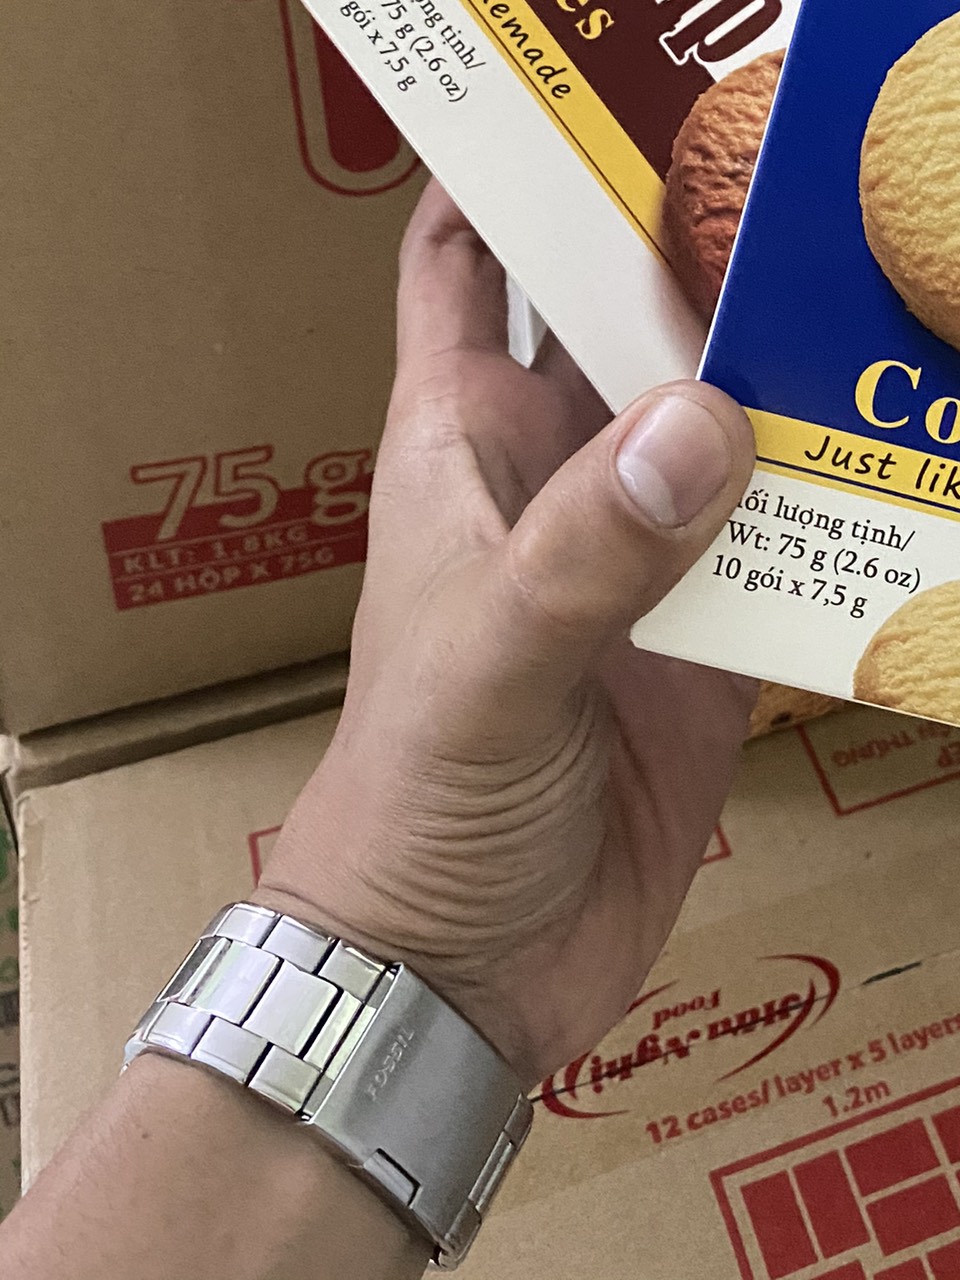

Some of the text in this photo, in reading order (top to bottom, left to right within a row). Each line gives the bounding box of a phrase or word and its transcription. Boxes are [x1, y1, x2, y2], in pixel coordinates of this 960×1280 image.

[340, 0, 376, 31] gói
[367, 29, 384, 46] x
[379, 41, 410, 73] 7,5
[397, 74, 418, 92] g
[395, 22, 415, 40] g
[409, 35, 448, 73] (2.6
[439, 72, 468, 103] oz)
[440, 24, 487, 70] tịnh/
[804, 434, 898, 481] Just
[737, 488, 917, 552] ối lượng tịnh/
[128, 580, 164, 602] 24
[250, 561, 271, 581] X
[712, 554, 868, 619] 10 gói x 7,5 g
[728, 519, 921, 595] Wt: 75 g (2.6 oz)
[645, 1116, 682, 1145] 12
[686, 1082, 772, 1133] cases/
[776, 1054, 843, 1098] layer
[846, 1048, 867, 1072] x
[867, 1039, 888, 1064] 5
[821, 1078, 892, 1119] 1.2m
